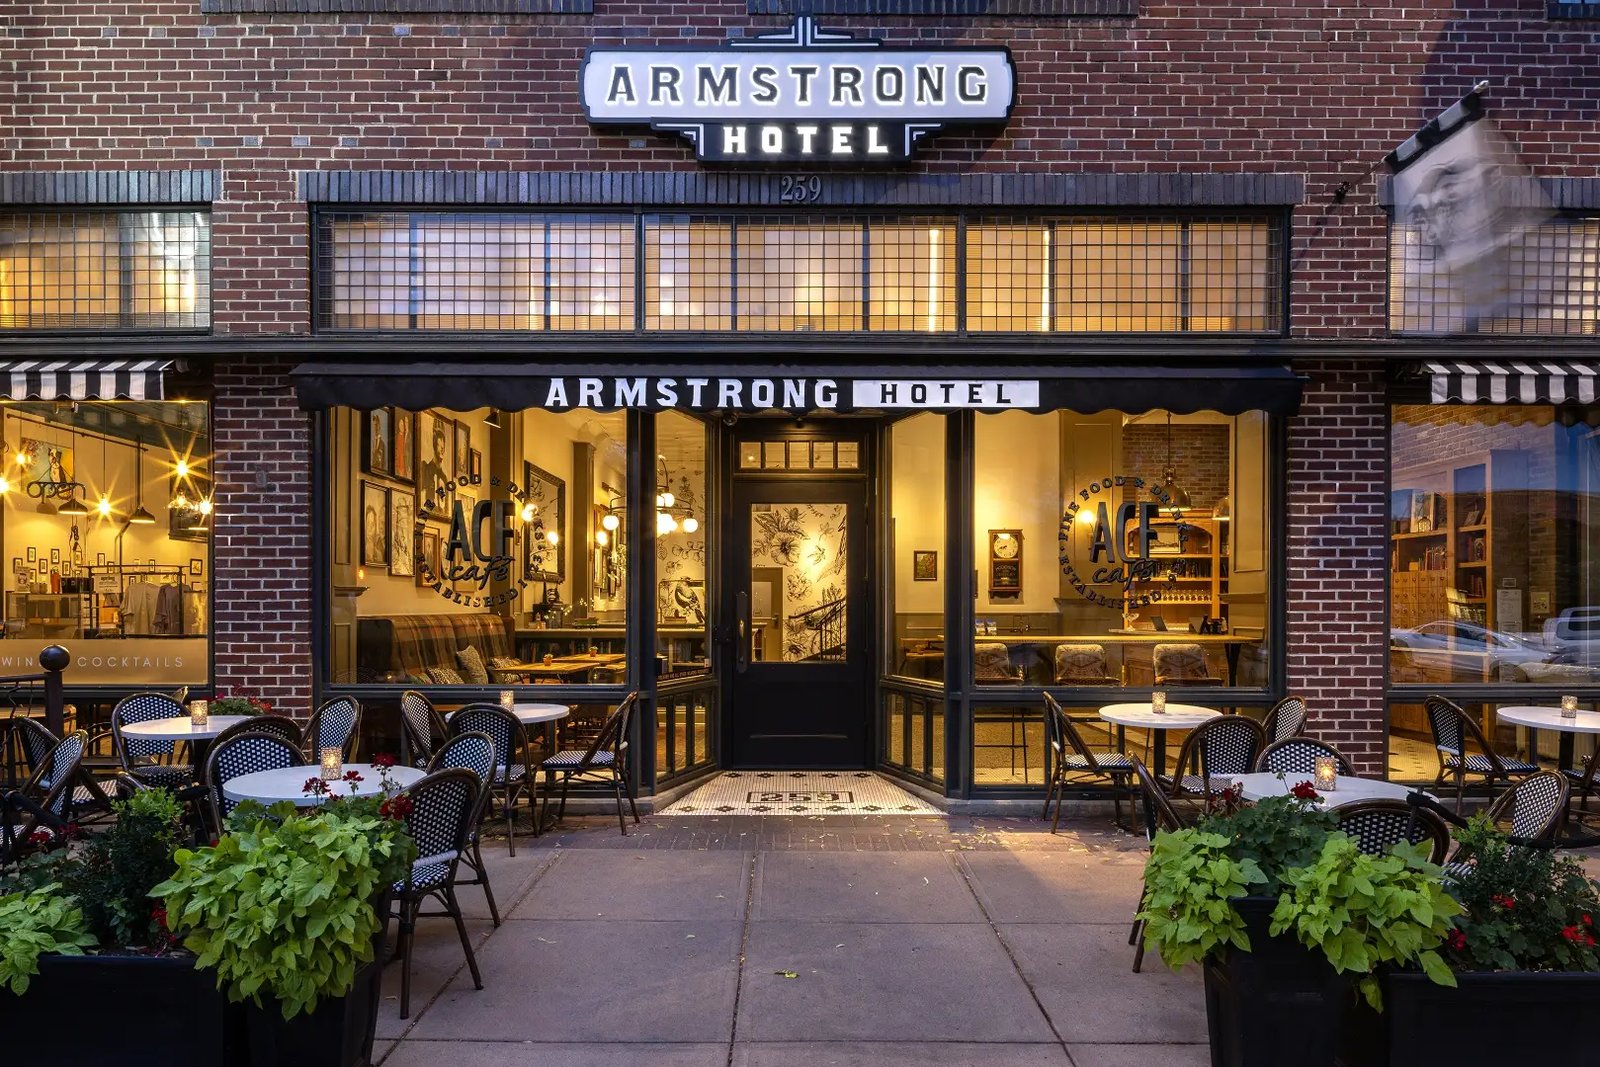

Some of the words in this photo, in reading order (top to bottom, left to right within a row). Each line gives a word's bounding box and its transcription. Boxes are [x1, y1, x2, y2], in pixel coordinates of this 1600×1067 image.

[606, 65, 989, 104] ARMSTRONG
[722, 125, 889, 154] HOTEL
[781, 175, 822, 202] 259
[543, 378, 839, 408] ARMSTRONG
[880, 383, 1012, 404] HOTEL
[435, 474, 482, 500] FOOD
[1058, 501, 1080, 542] FINE
[1079, 475, 1127, 501] FOOD
[445, 499, 516, 562] ACE
[1089, 501, 1160, 564] ACE
[1, 656, 42, 668] WIN
[77, 656, 183, 668] COCKTAILS
